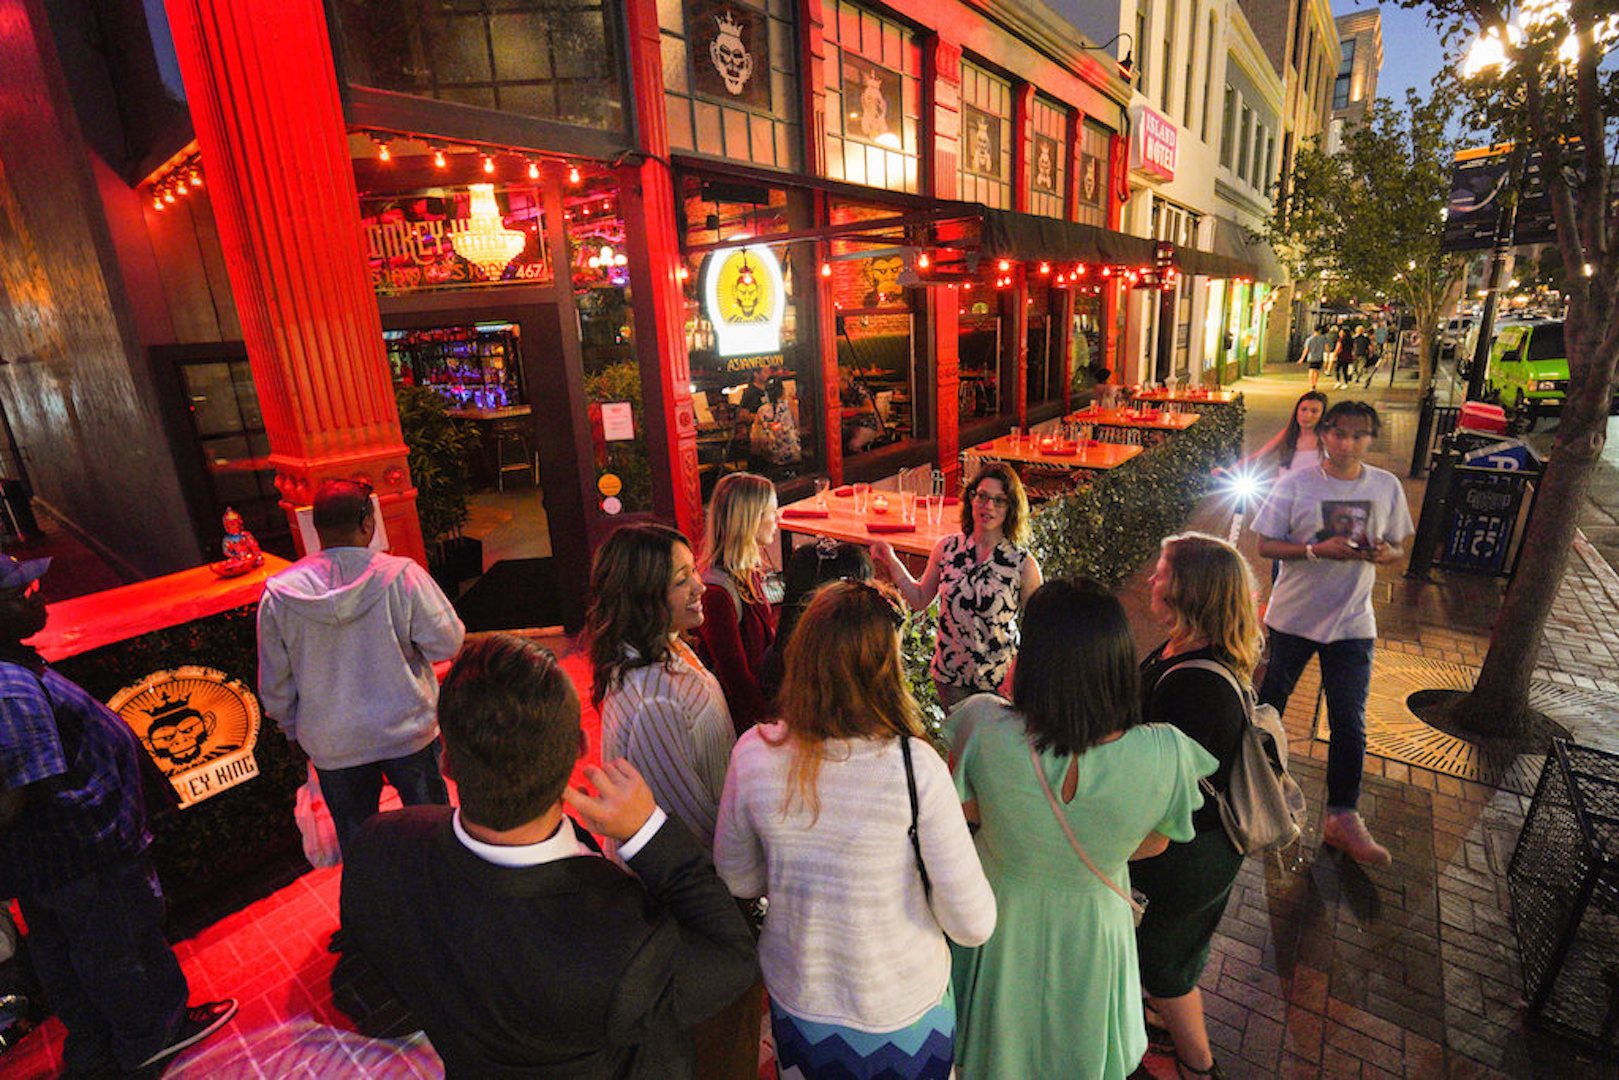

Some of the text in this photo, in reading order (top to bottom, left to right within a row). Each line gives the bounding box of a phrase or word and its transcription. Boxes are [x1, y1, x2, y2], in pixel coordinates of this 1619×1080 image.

[1146, 112, 1175, 147] ISLAND
[1146, 135, 1174, 172] HOTEL
[367, 220, 444, 265] ONKEY
[515, 263, 543, 279] 467
[215, 755, 254, 785] KING
